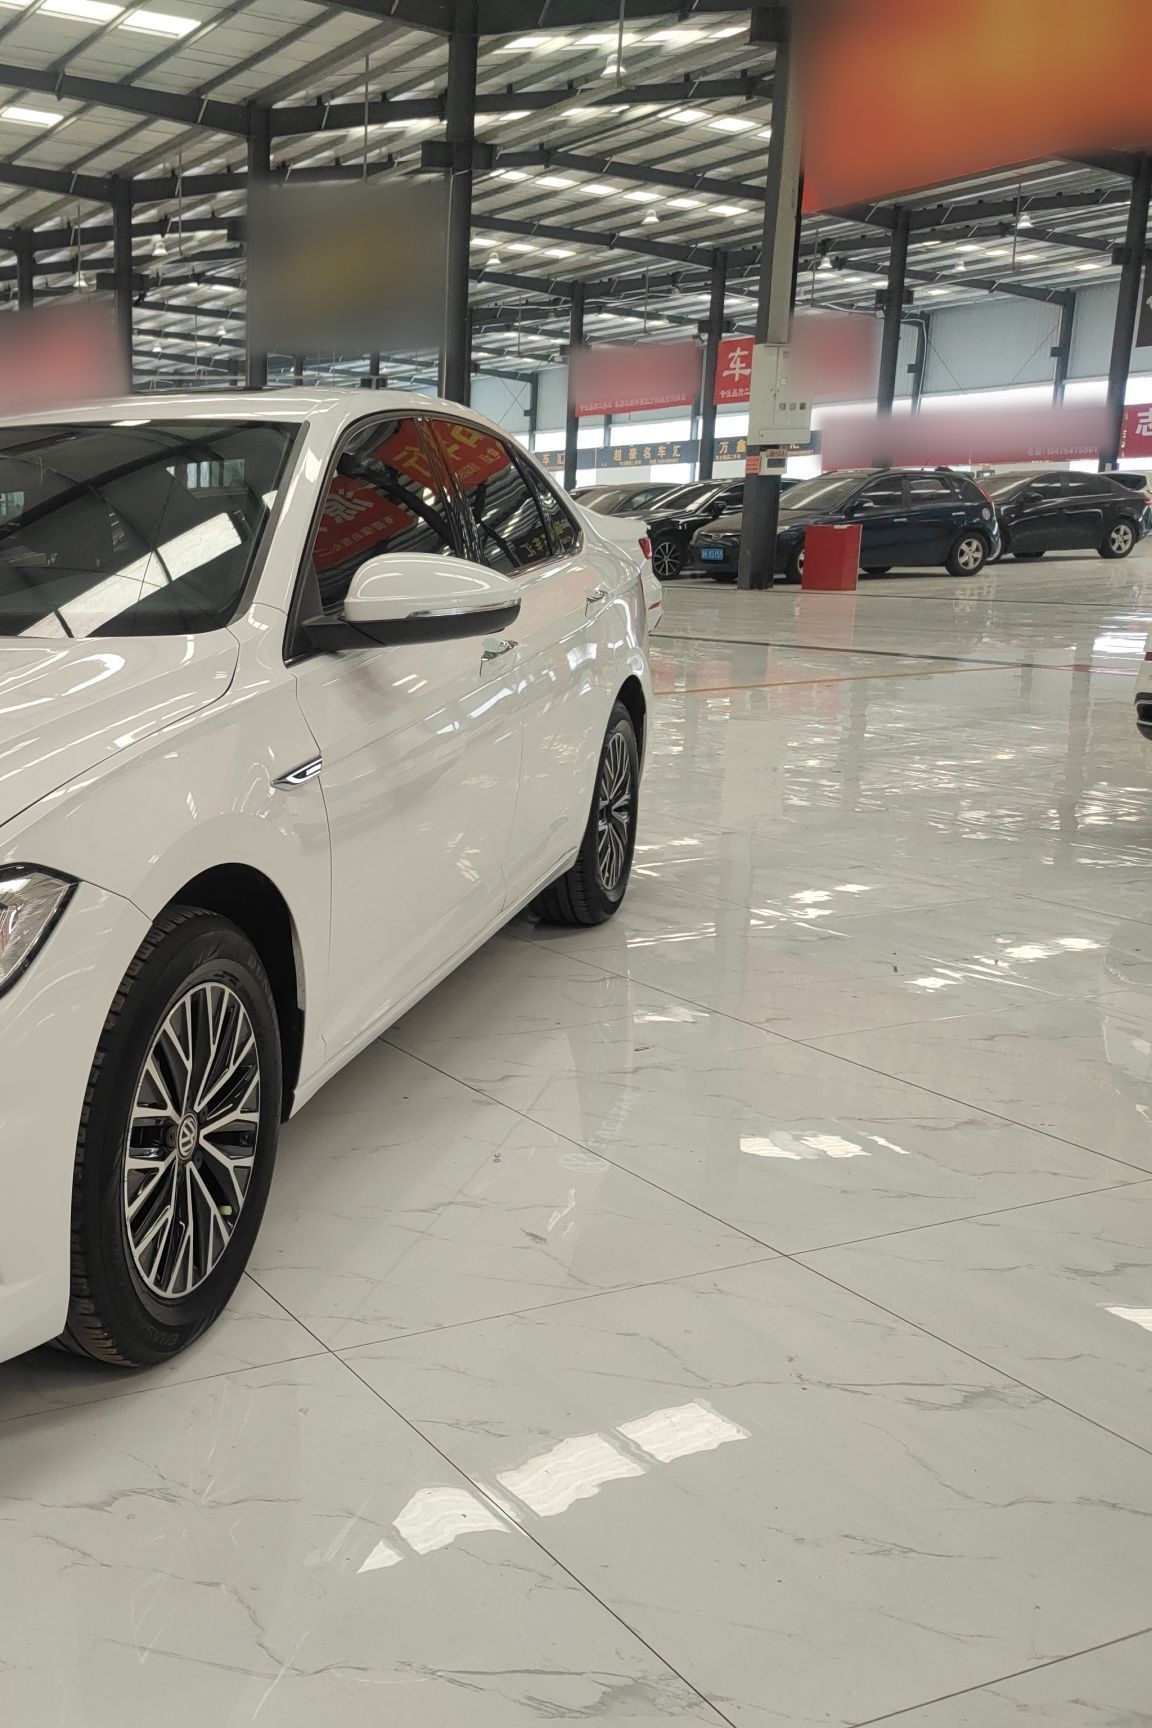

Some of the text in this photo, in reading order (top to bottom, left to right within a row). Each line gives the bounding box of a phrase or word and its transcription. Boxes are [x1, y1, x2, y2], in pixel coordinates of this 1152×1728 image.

[723, 347, 752, 382] 车
[613, 445, 681, 462] 超豪名车汇
